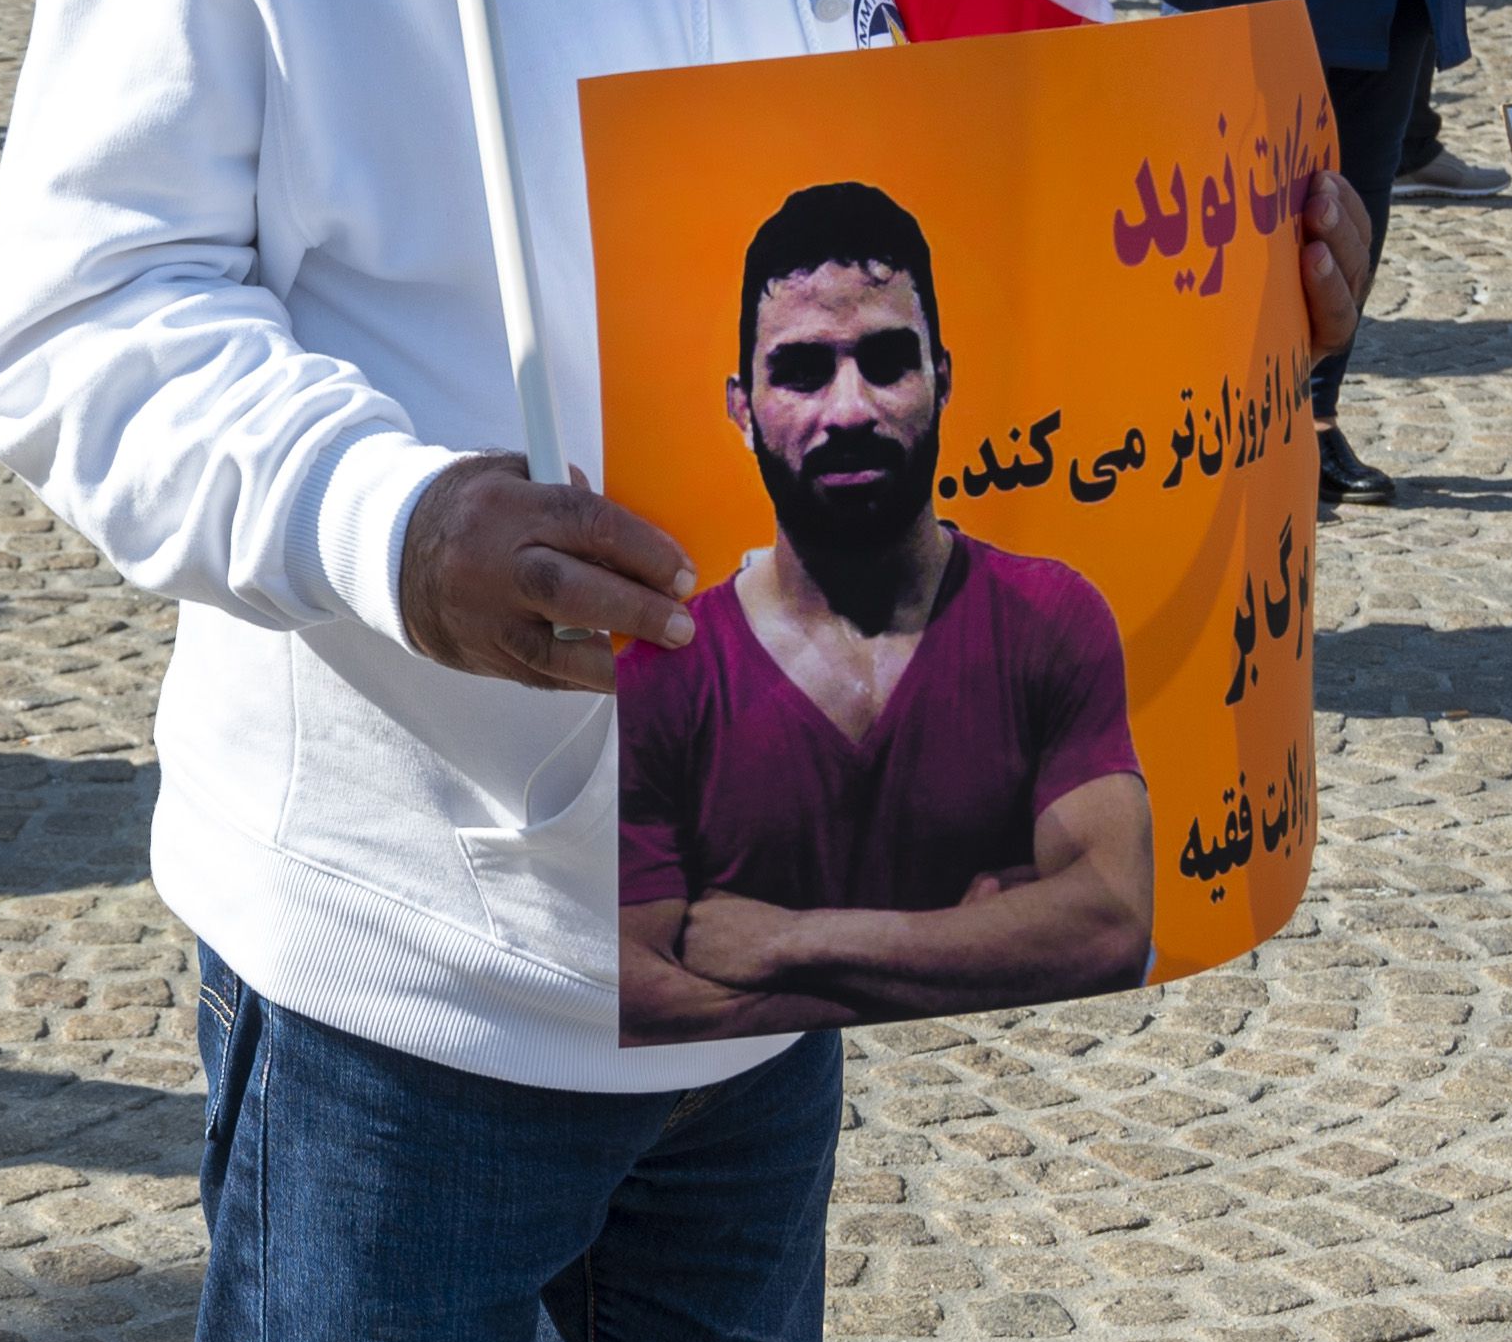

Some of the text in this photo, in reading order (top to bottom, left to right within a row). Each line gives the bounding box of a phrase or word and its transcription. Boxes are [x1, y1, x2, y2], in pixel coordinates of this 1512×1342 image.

[1113, 112, 1237, 297] نوید
[938, 408, 1062, 500] کند.
[1069, 426, 1147, 505] می
[1225, 512, 1309, 707] مرگ بر
[1179, 770, 1254, 905] فقیه
